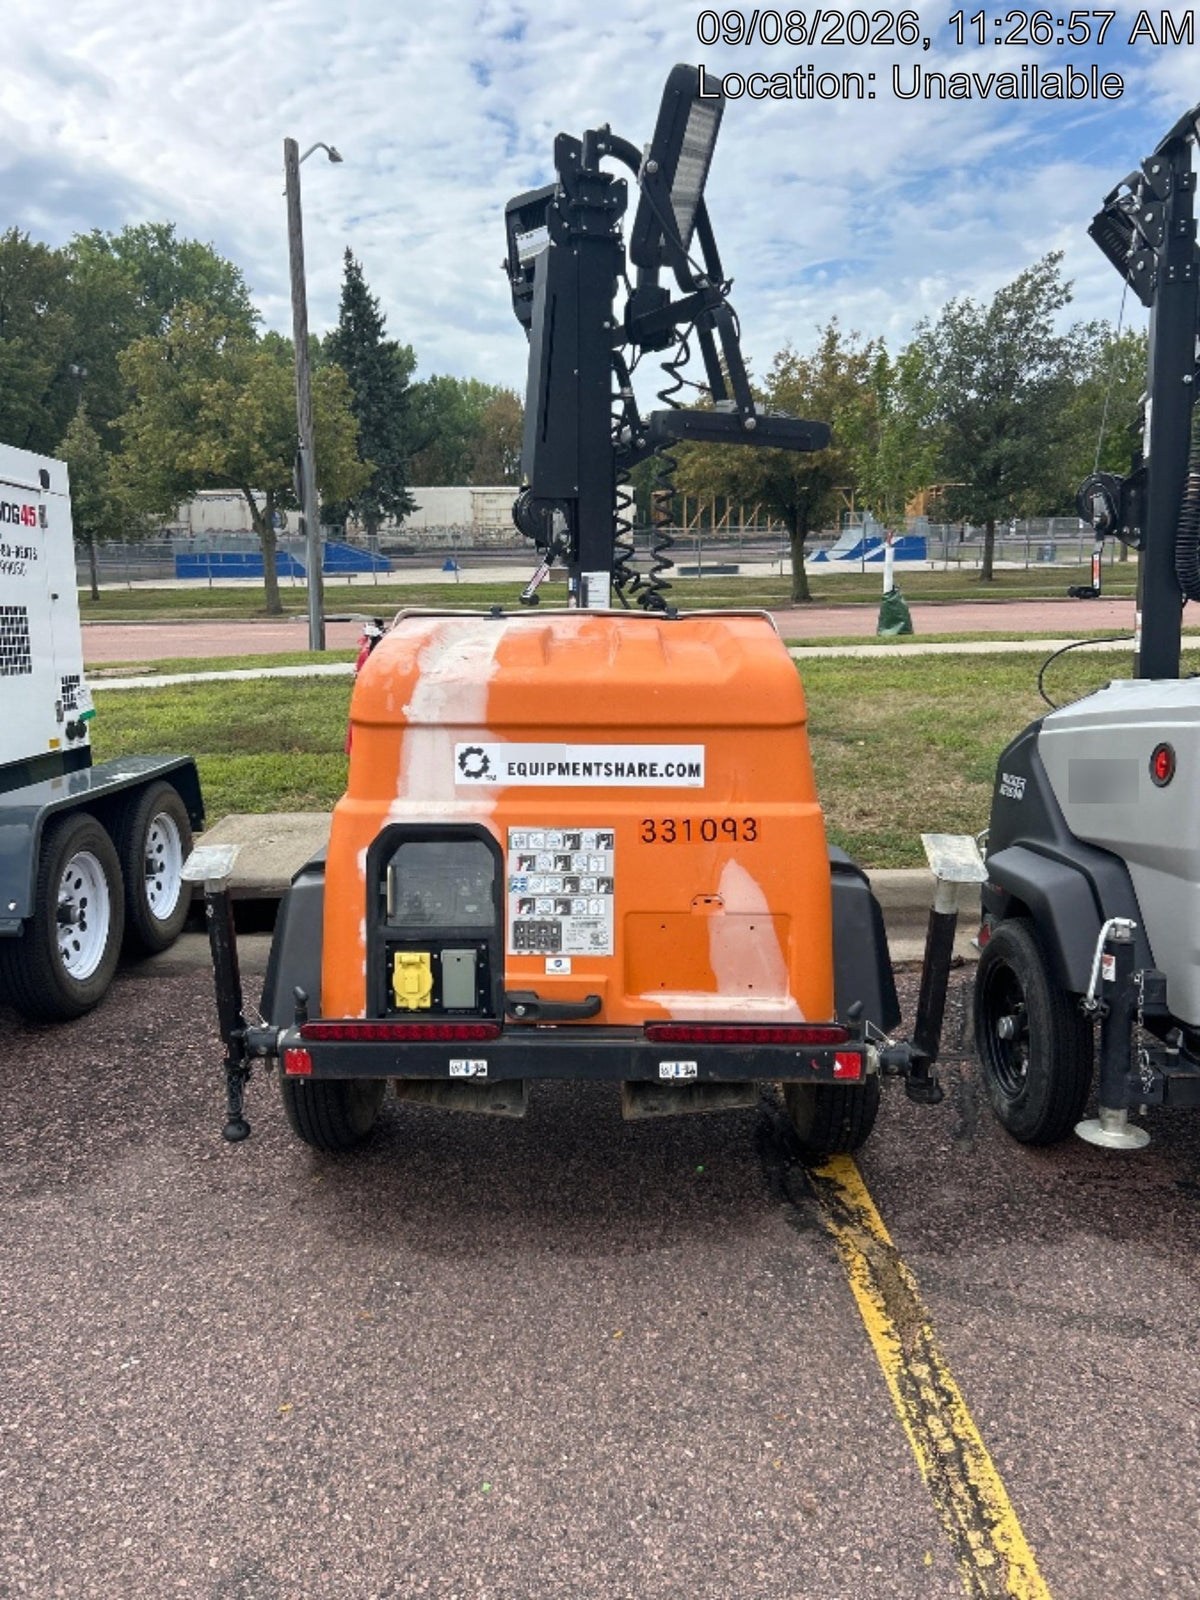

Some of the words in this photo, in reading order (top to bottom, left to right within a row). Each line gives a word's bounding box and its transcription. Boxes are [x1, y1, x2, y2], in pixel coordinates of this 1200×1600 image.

[0, 501, 36, 527] DG45
[507, 761, 701, 778] EQUIPMENTSHARE.COM
[641, 817, 757, 843] 331093
